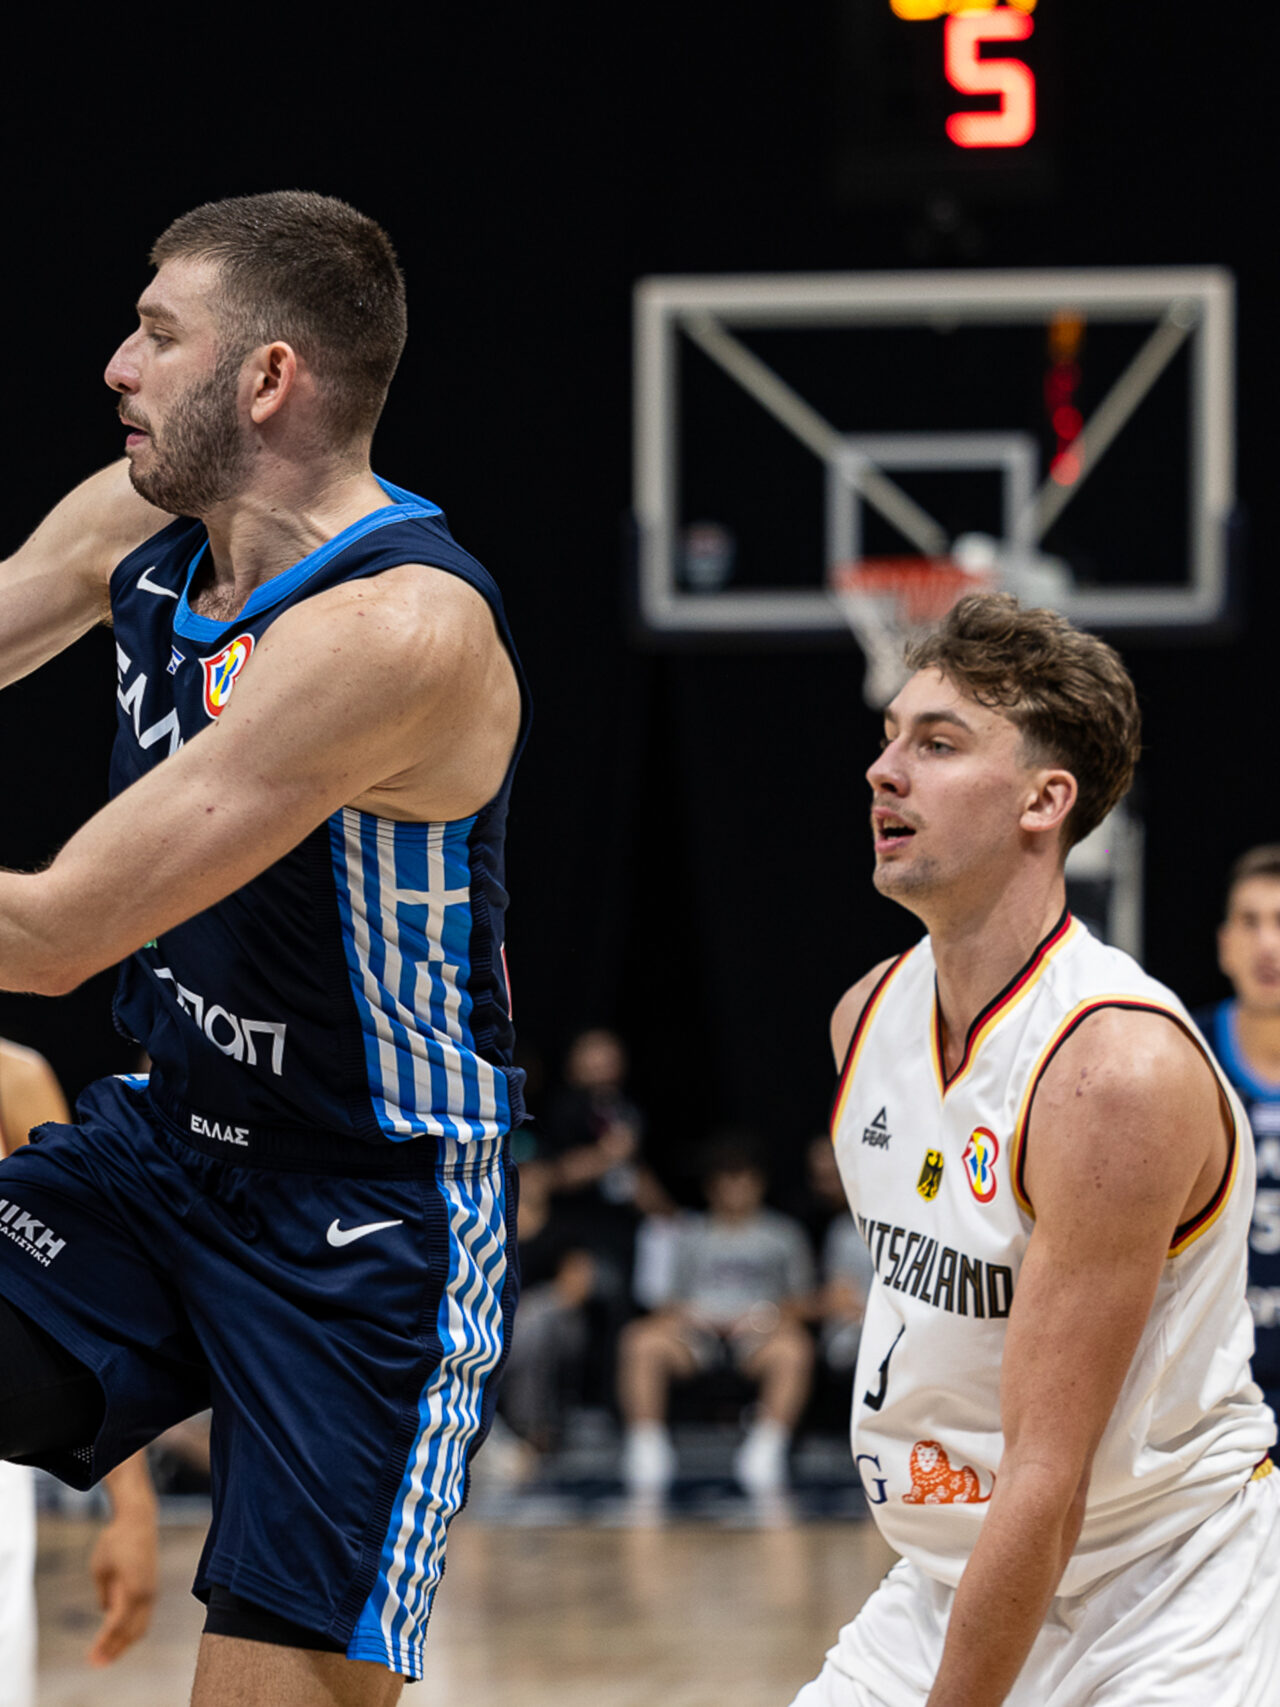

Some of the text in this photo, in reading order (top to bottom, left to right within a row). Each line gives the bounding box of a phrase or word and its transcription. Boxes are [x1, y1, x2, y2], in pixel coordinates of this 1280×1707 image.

[944, 6, 1036, 148] 5
[190, 1114, 250, 1146] ΕΛΛΑΣ
[862, 1127, 892, 1150] PEAK
